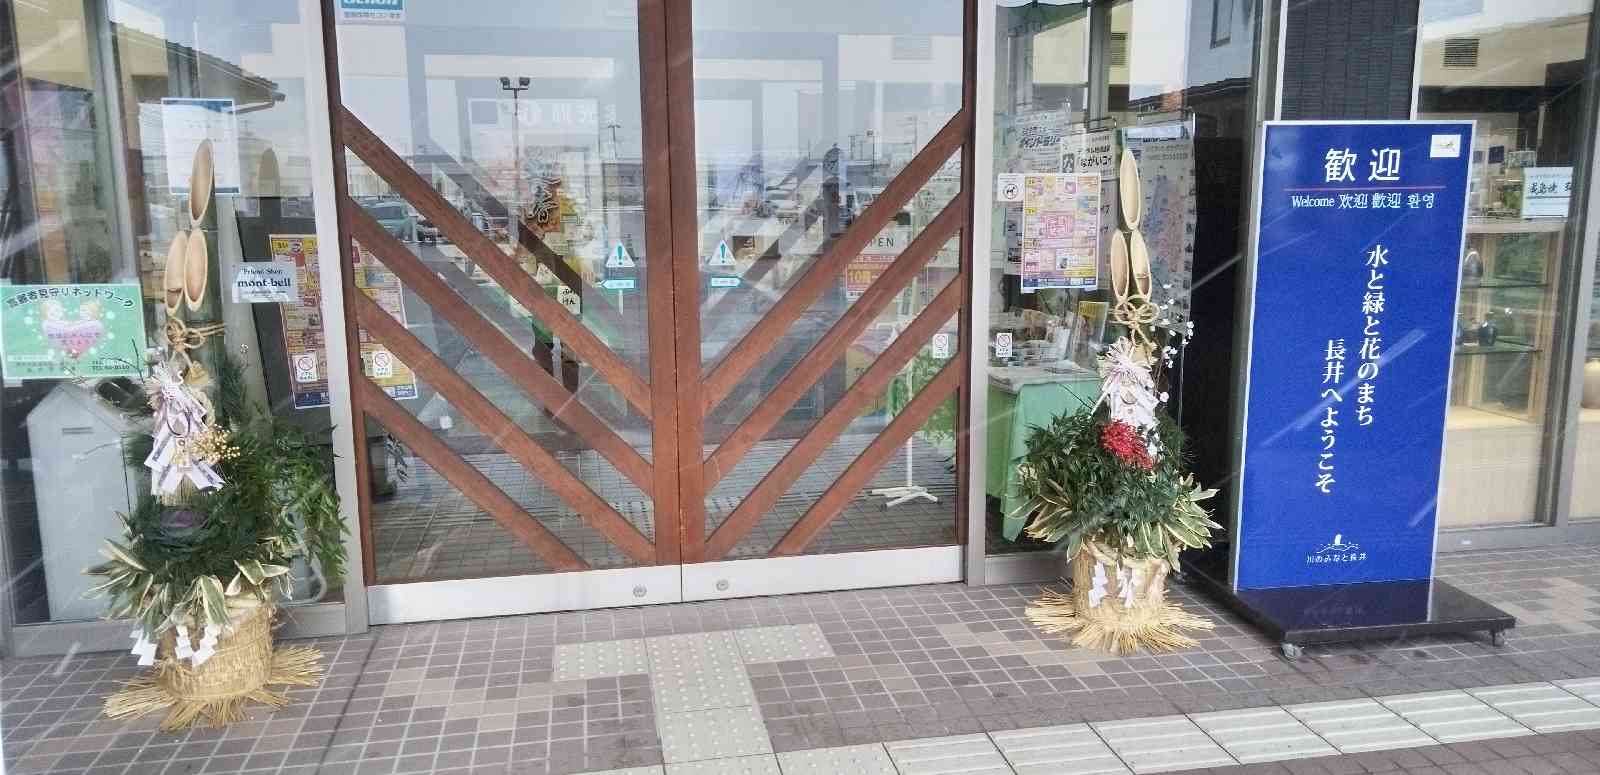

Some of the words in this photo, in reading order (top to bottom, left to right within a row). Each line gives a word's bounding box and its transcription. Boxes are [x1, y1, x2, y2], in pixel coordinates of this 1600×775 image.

[1324, 148, 1401, 183] 歓迎
[1291, 194, 1336, 208] Welcome
[1338, 192, 1368, 209] 欢迎
[1407, 192, 1435, 209] 환영
[237, 277, 291, 288] mont-bell
[1356, 245, 1389, 426] 水と緑と花のまち
[1315, 338, 1347, 494] 長井へようこそ
[1305, 553, 1367, 564] 川のみなと長井
